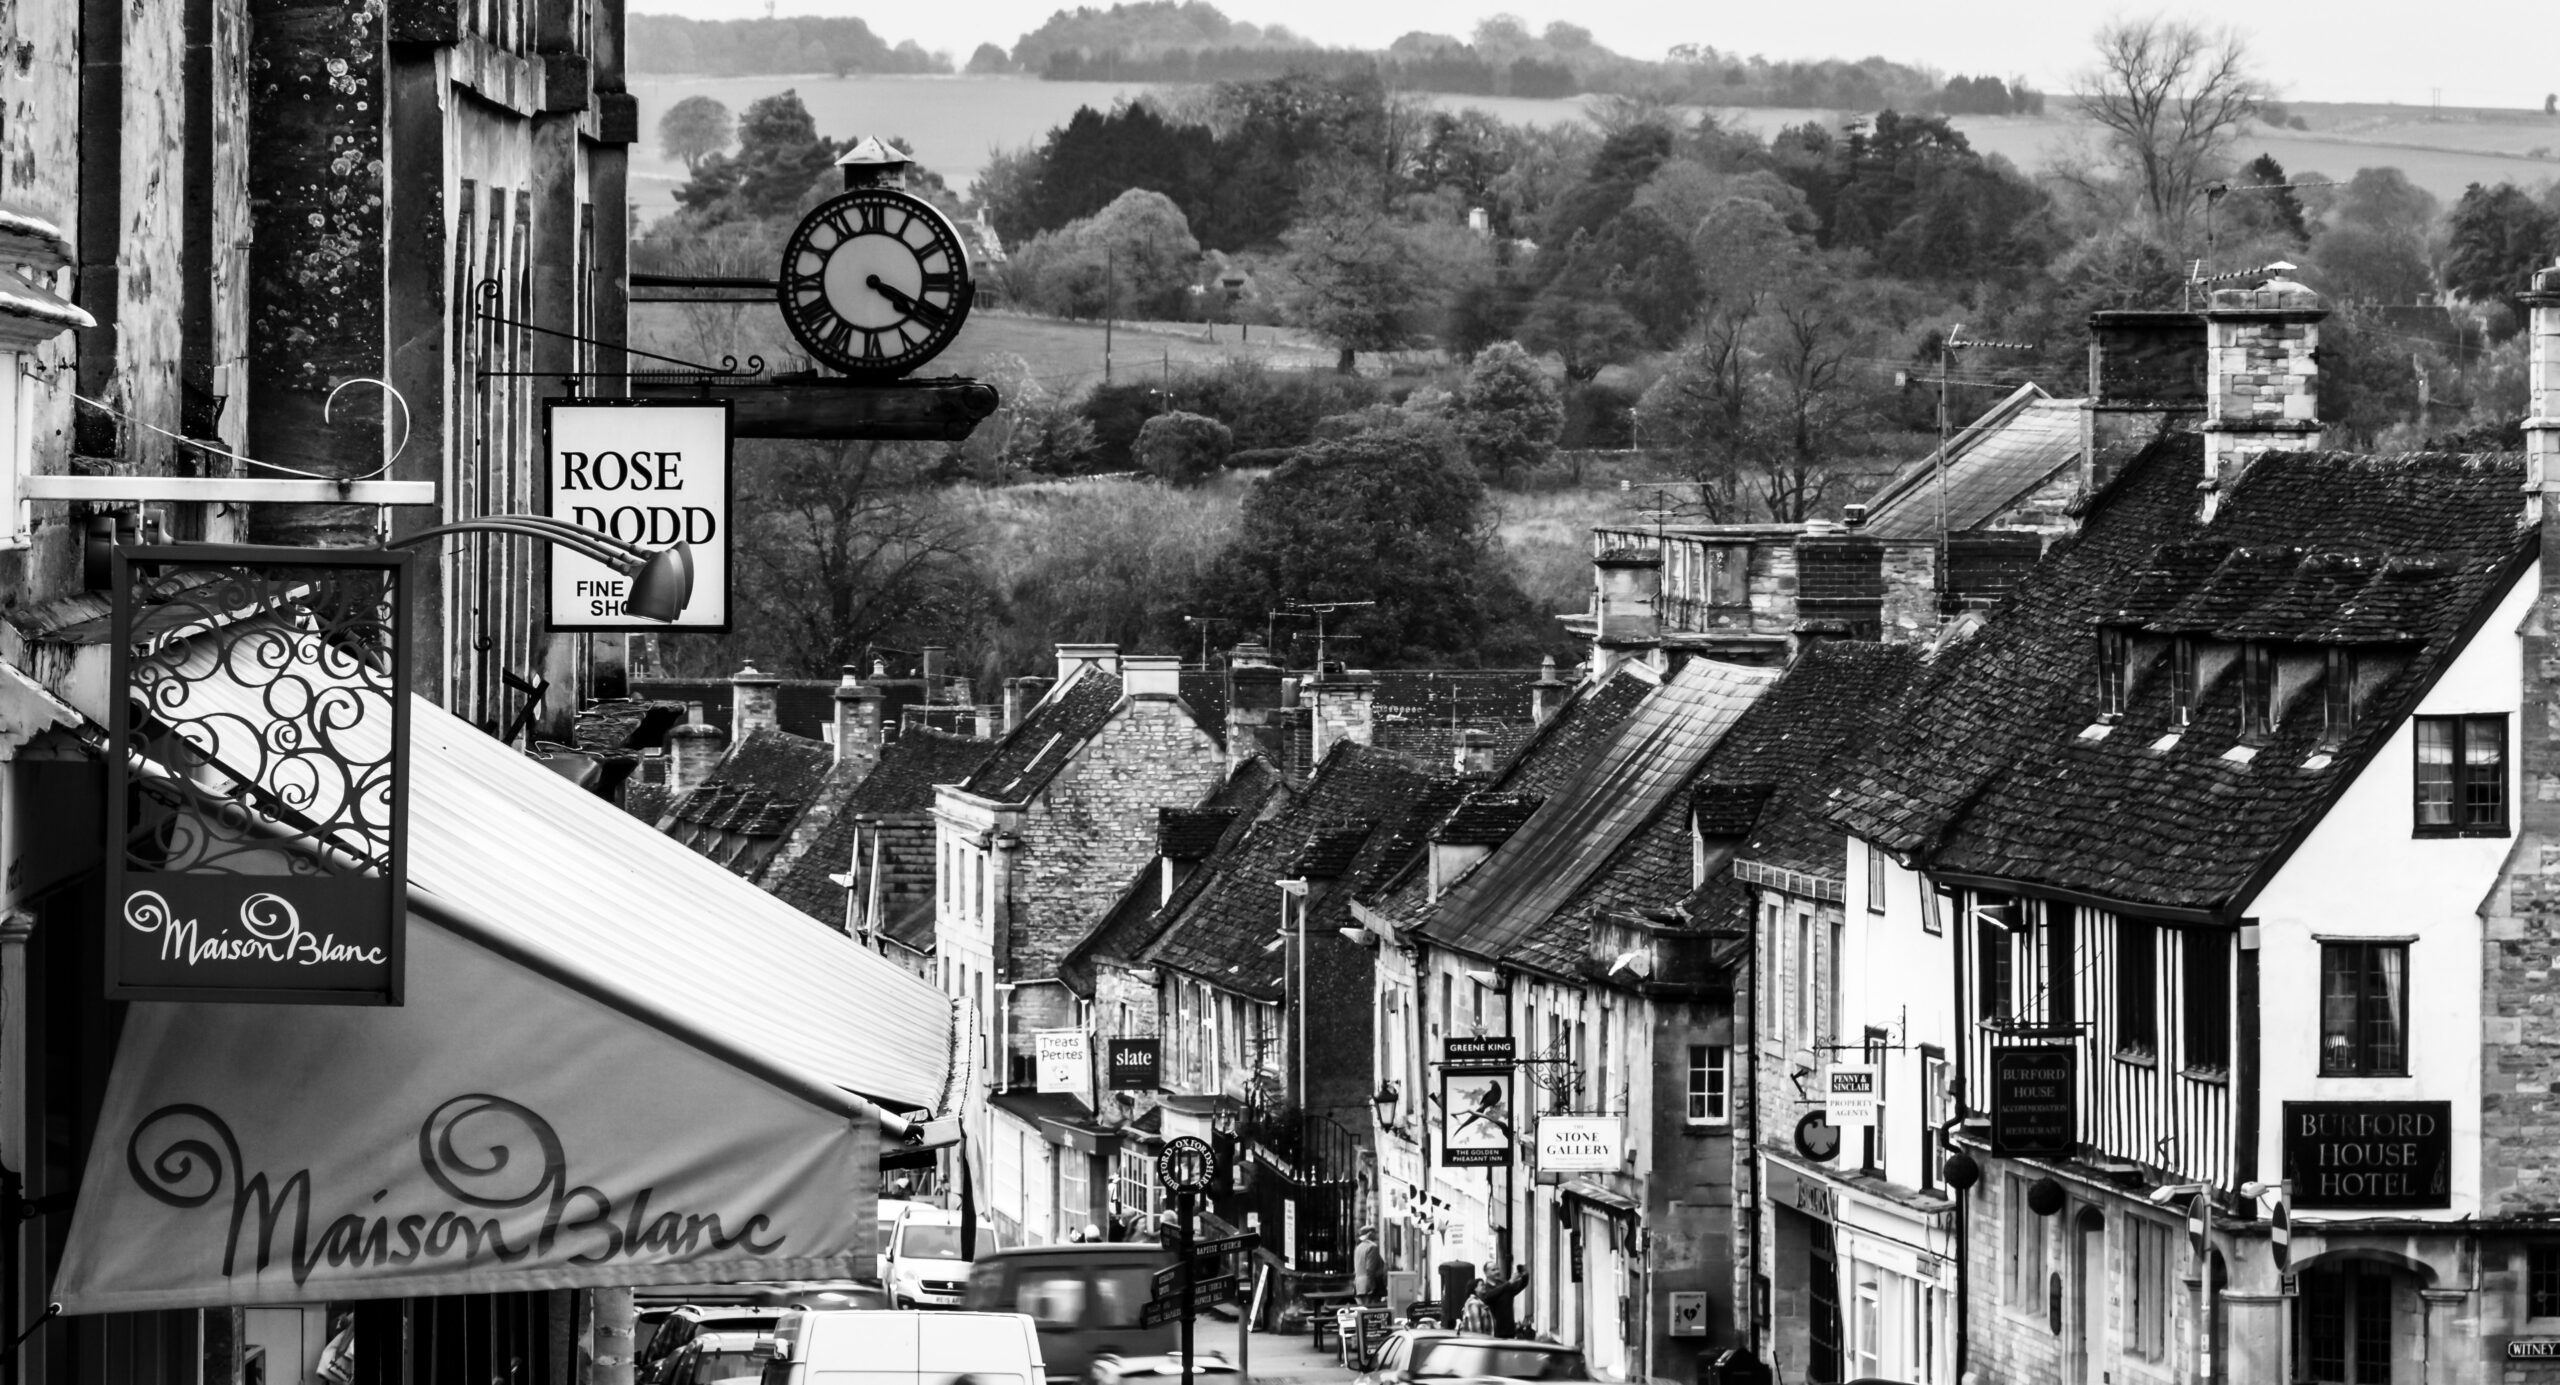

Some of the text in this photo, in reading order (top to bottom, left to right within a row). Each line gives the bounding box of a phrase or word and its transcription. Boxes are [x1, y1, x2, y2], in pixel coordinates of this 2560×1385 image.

[561, 451, 683, 491] ROSE
[573, 506, 716, 546] DODD
[577, 581, 624, 597] FINE
[125, 890, 387, 967] Maison Blanc
[1040, 1037, 1079, 1048] Treats
[1450, 1043, 1511, 1052] GREENE KING
[1041, 1050, 1083, 1061] Petites
[1116, 1048, 1152, 1066] slate
[1834, 1075, 1867, 1083] PENNY &
[2003, 1068, 2065, 1081] BURFORD
[1834, 1083, 1870, 1091] SINCLAIR
[2014, 1086, 2056, 1098] HOUSE
[1830, 1099, 1873, 1107] PROPERTY
[2301, 1113, 2436, 1137] BURFORD
[1556, 1132, 1599, 1142] STONE
[1547, 1145, 1610, 1155] GALLERY
[2319, 1143, 2417, 1167] HOUSE
[126, 1093, 786, 1287] Maison Blanc
[2320, 1172, 2417, 1197] HOTEL
[2513, 1343, 2556, 1355] WITNEY
